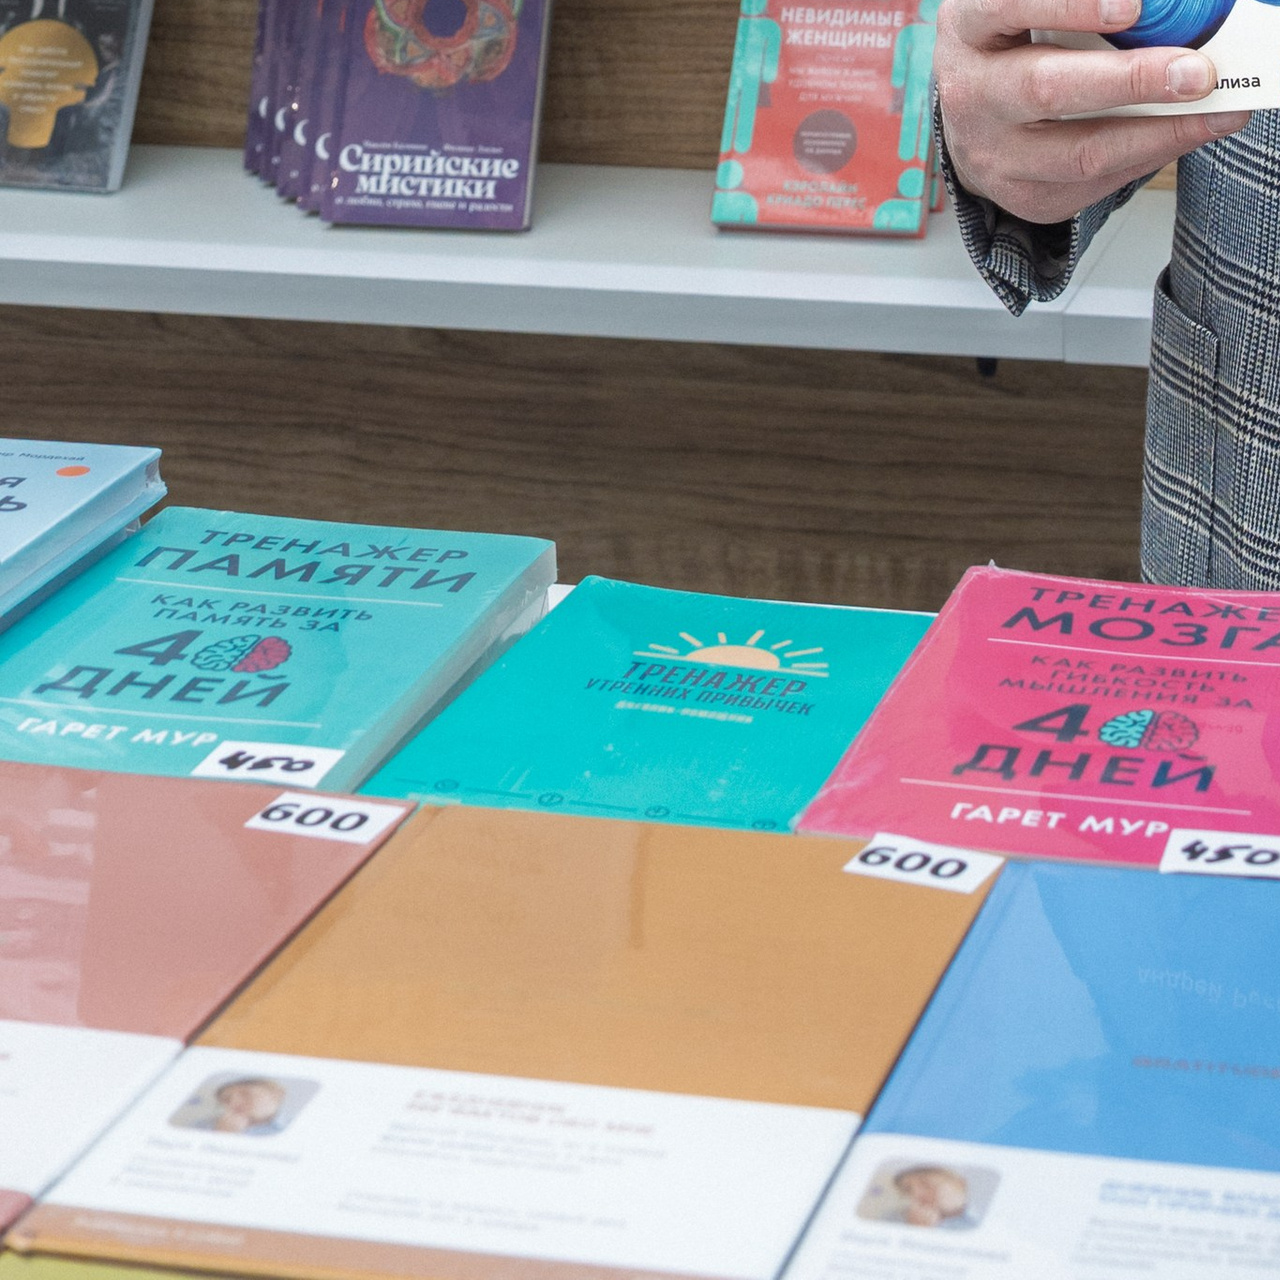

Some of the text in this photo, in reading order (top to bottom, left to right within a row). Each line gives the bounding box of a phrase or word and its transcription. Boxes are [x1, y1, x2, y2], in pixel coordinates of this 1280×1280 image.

[780, 6, 905, 28] НЕВИДИМЫЕ
[785, 28, 893, 50] ЖЕНЩИНЫ
[338, 141, 520, 180] Сирийские
[354, 172, 498, 200] мистики
[18, 452, 86, 462] Мордехай
[198, 529, 470, 564] ТРЕНАЖЕР
[134, 546, 478, 593] ПАМЯТИ
[150, 593, 374, 622] КАК РАЗВИТЬ
[153, 607, 342, 633] ПАМЯТЬ ЗА
[622, 660, 809, 698] ТРЕНАЖЕР
[1030, 654, 1250, 685] КАК РАЗВИТЬ
[1050, 667, 1217, 695] ГИБКОСТЬ
[31, 664, 293, 708] ДНЕЙ
[584, 677, 693, 701] УТРЕННИХ
[695, 690, 816, 717] ПРИВЫЧЕК
[997, 678, 1256, 710] МЫШЛЕНИЯ ЗА
[15, 716, 220, 748] ГАРЕТ МУР
[217, 750, 316, 774] 450
[950, 743, 1218, 794] ДНЕЙ
[260, 801, 371, 834] 600
[950, 802, 1170, 839] ГАРЕТ МУР
[857, 845, 969, 880] 600
